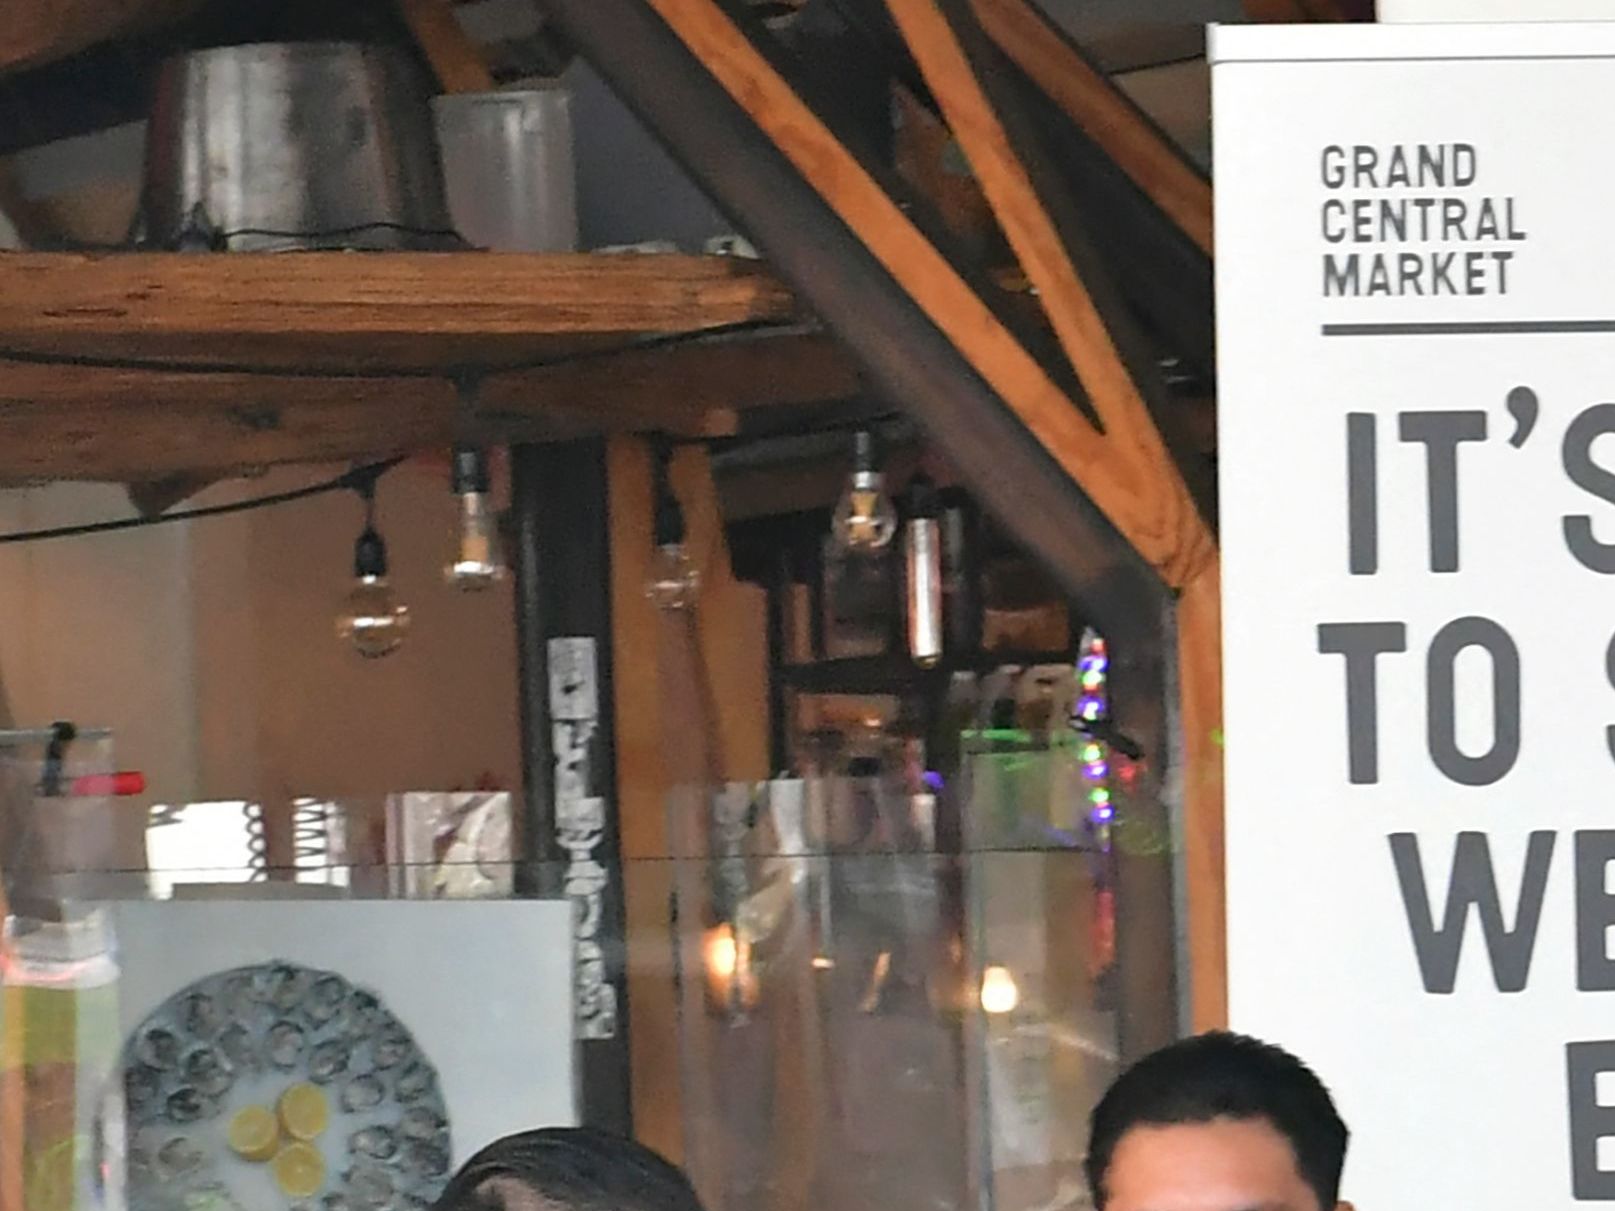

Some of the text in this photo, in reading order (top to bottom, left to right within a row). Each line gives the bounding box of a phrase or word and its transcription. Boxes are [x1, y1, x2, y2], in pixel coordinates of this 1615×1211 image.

[1321, 143, 1478, 189] GRAND
[1322, 197, 1527, 244] CENTRAL
[1323, 251, 1515, 297] MARKET
[1316, 615, 1522, 788] TO
